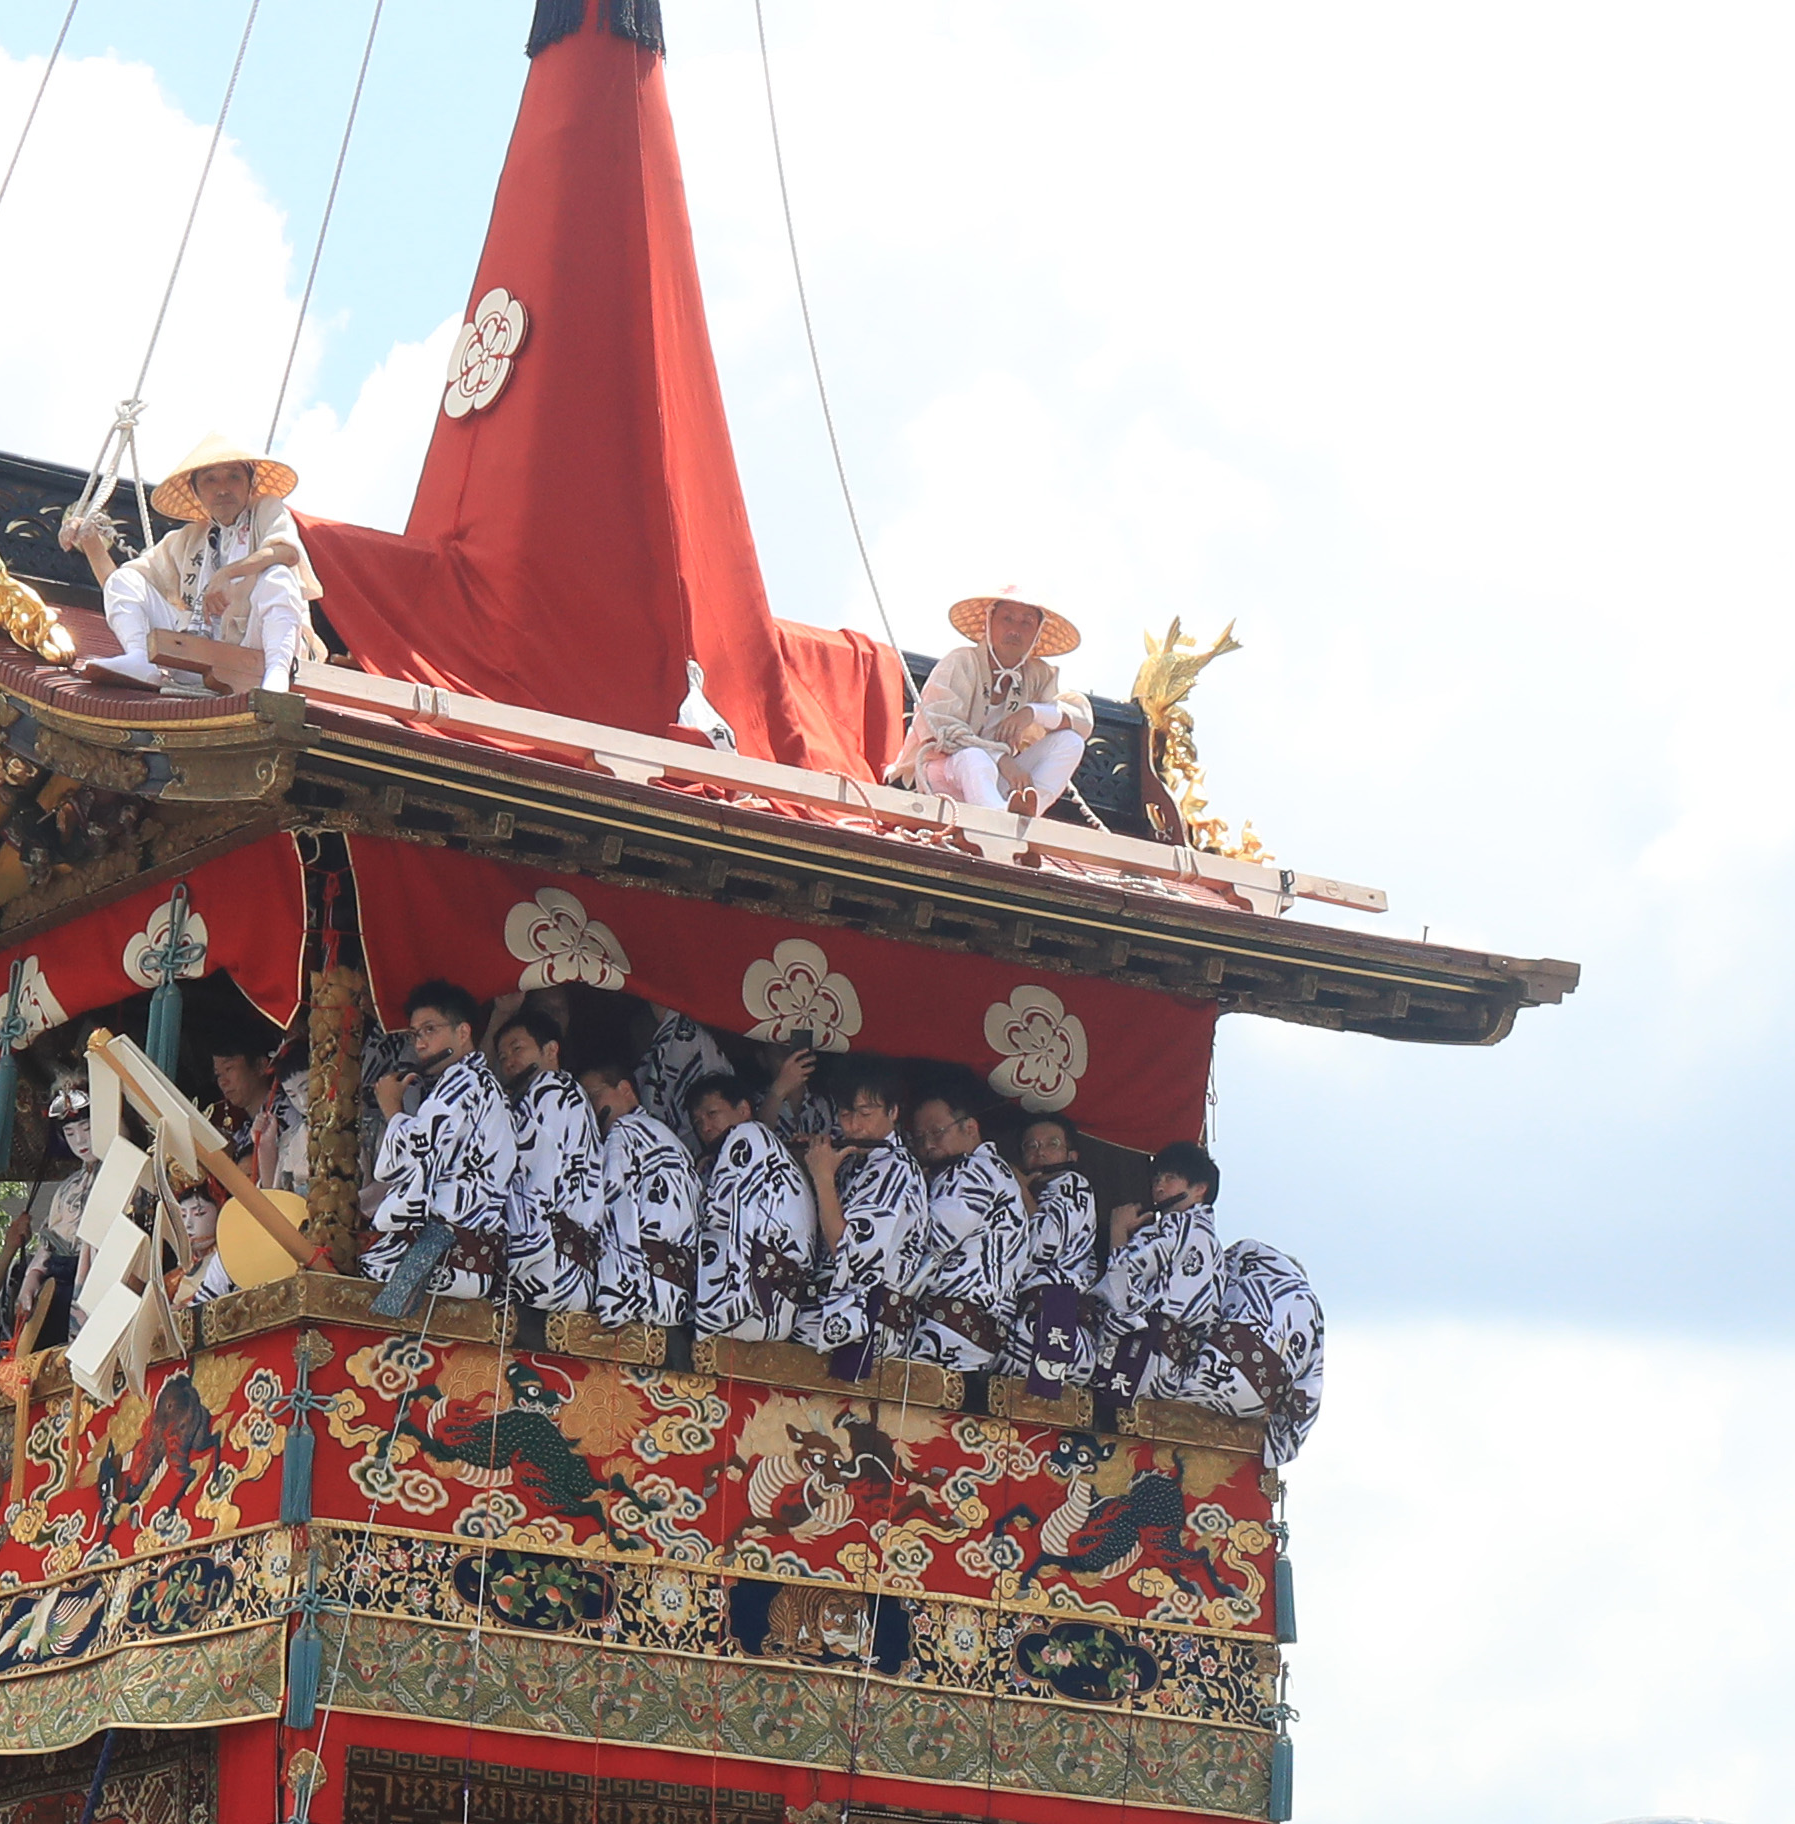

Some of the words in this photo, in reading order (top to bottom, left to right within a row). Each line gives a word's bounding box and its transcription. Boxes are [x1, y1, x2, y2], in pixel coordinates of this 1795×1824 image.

[765, 1152, 802, 1197] 長
[1047, 1326, 1072, 1352] 長
[1111, 1371, 1132, 1397] 長
